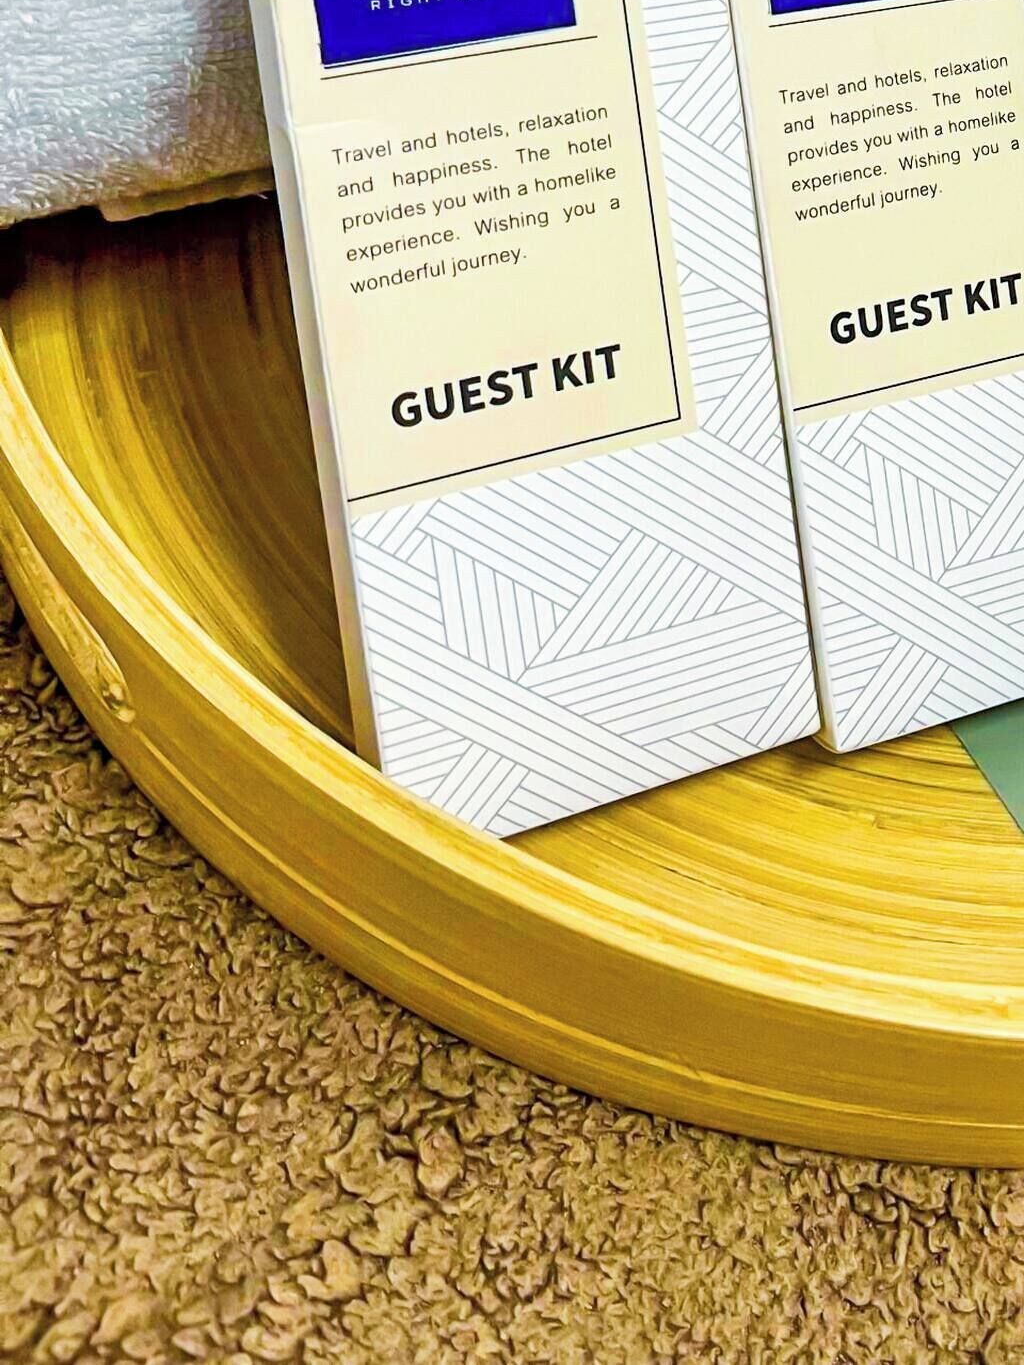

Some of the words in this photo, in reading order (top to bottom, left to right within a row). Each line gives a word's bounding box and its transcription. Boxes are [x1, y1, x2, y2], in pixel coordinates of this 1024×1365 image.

[778, 83, 829, 105] Travel
[837, 77, 867, 95] and
[874, 69, 927, 88] hotels,
[934, 54, 1008, 78] relaxation
[783, 116, 814, 134] and
[830, 99, 918, 127] happiness.
[932, 92, 961, 107] The
[975, 82, 1012, 100] hotel
[332, 140, 392, 166] Travel
[402, 133, 437, 154] and
[446, 123, 510, 146] hotels,
[518, 105, 609, 133] relaxation
[787, 139, 858, 166] provides
[864, 133, 892, 151] you
[897, 126, 929, 142] with
[934, 124, 943, 136] a
[948, 110, 1016, 133] homelike
[337, 177, 374, 198] and
[392, 156, 498, 189] happiness.
[516, 146, 550, 165] The
[568, 135, 613, 155] hotel
[791, 165, 887, 192] experience.
[899, 149, 961, 170] Wishing
[973, 141, 999, 161] you
[1011, 138, 1020, 150] a
[342, 200, 426, 233] provides
[433, 197, 466, 216] you
[473, 186, 511, 205] with
[517, 182, 528, 197] a
[534, 165, 617, 192] homelike
[795, 194, 875, 221] wonderful
[879, 183, 943, 208] journey.
[346, 229, 460, 262] experience.
[474, 211, 549, 236] Wishing
[563, 200, 596, 222] you
[610, 196, 620, 211] a
[350, 260, 446, 294] wonderful
[451, 248, 527, 278] journey.
[830, 288, 953, 345] GUEST
[964, 273, 1022, 314] KIT
[391, 363, 538, 428] GUEST
[552, 344, 621, 391] KIT
